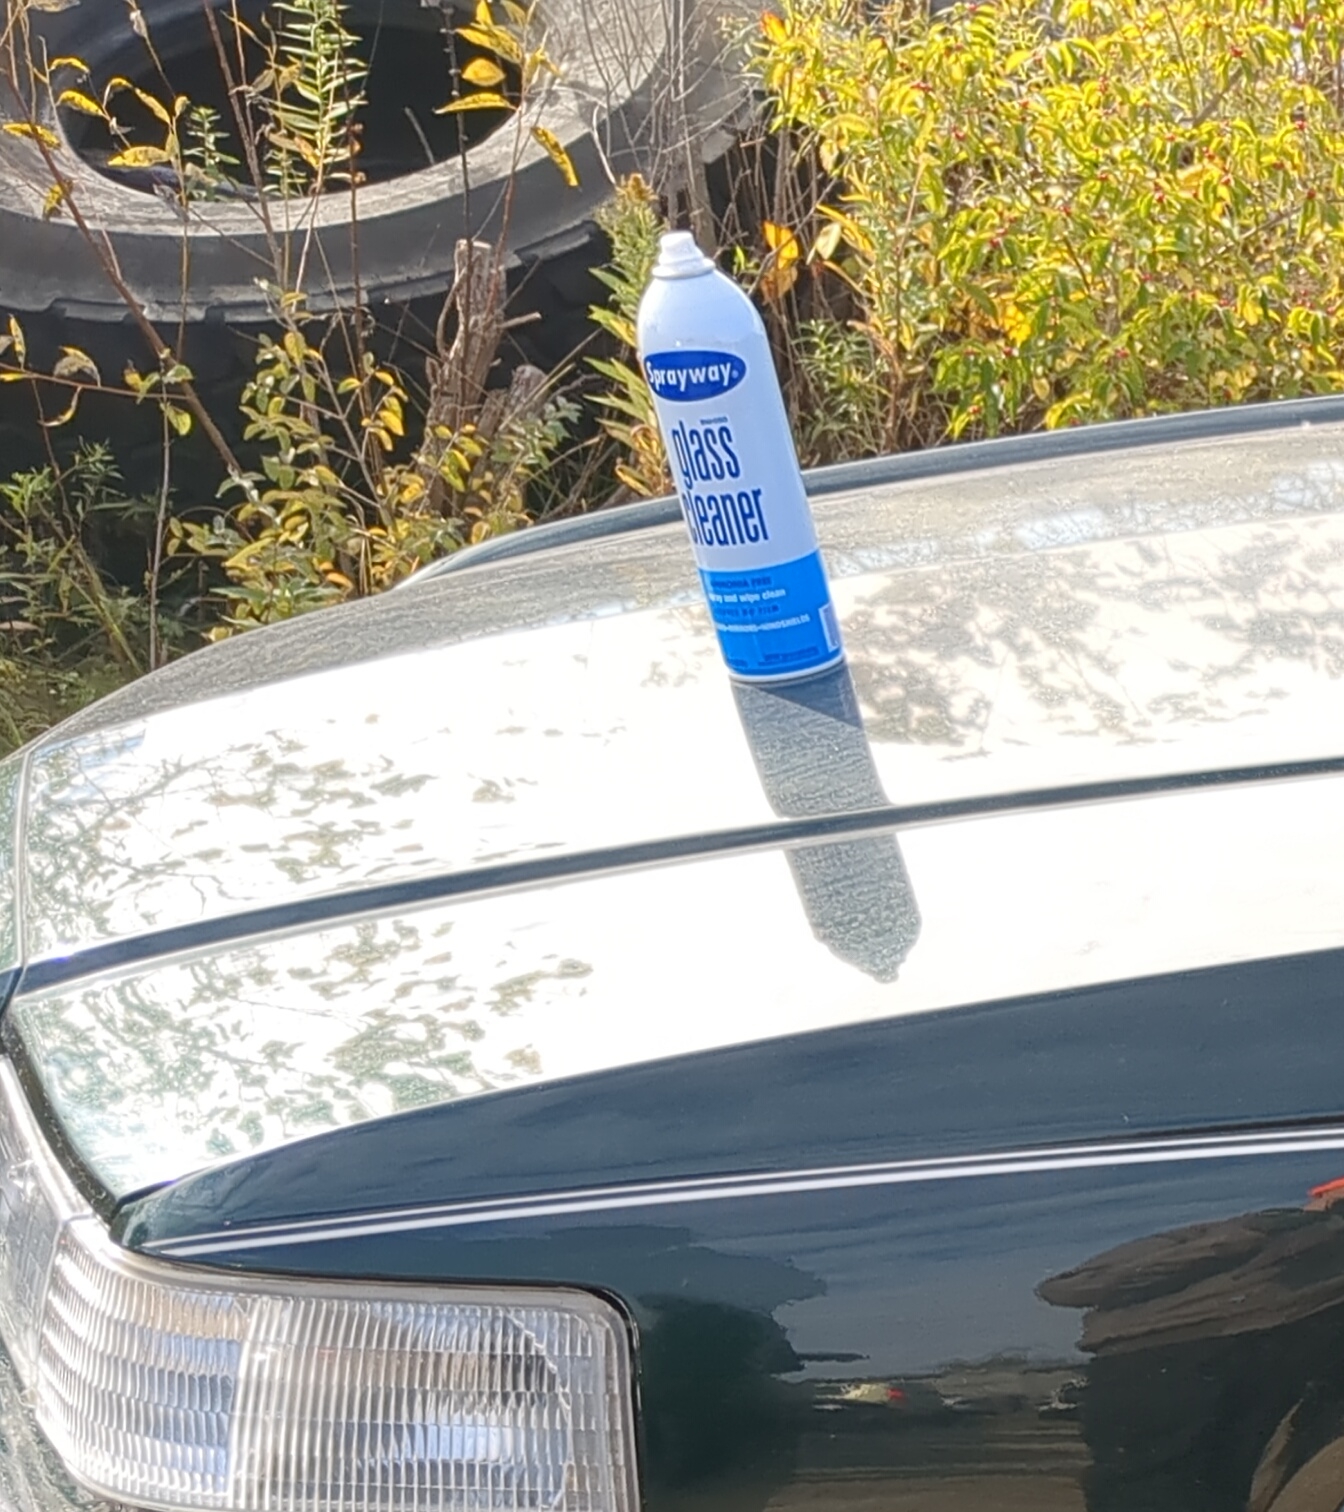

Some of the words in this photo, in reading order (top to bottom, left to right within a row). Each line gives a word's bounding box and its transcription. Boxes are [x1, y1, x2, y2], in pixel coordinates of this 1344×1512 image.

[646, 361, 731, 392] Sprayway
[672, 420, 740, 490] glass
[762, 589, 786, 600] clean
